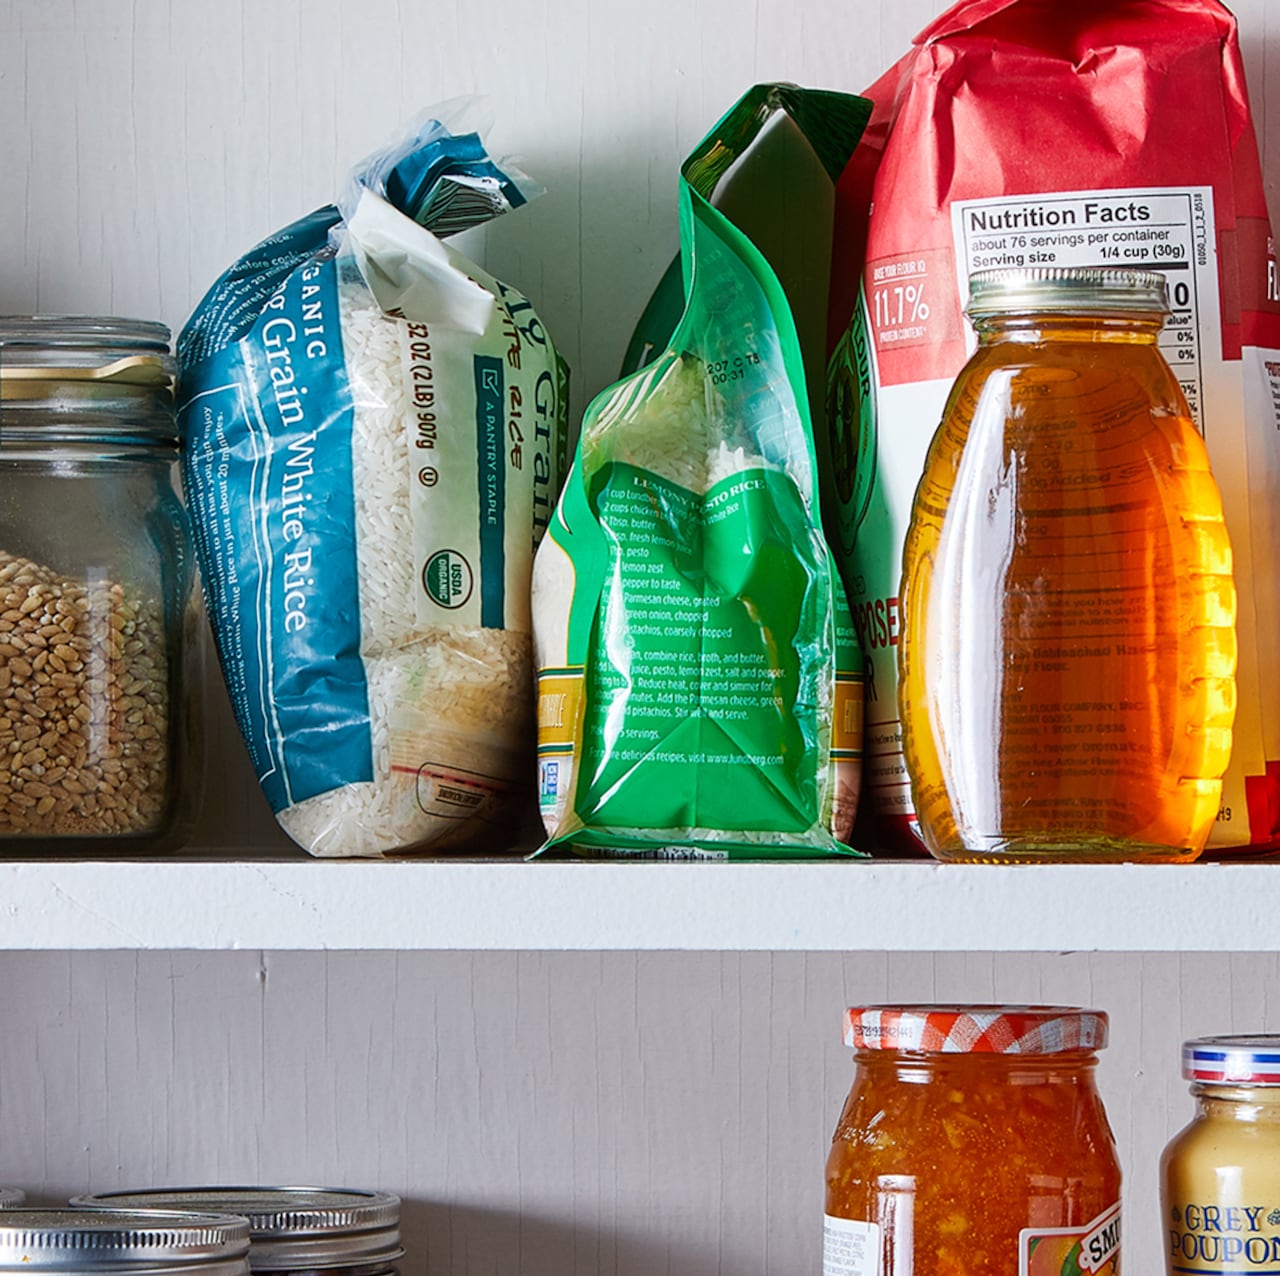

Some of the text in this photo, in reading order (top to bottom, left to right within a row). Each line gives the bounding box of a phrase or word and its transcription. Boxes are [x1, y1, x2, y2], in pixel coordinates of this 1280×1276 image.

[971, 202, 1151, 232] Nutrition Facts
[972, 228, 1170, 252] about 76 servings per container
[972, 250, 1056, 269] Serving size
[1100, 243, 1186, 260] 1/4 cup (30g)
[301, 263, 326, 360] GANIC
[874, 283, 930, 328] 11.7%
[407, 322, 428, 339] 32
[1177, 331, 1194, 342] 0%
[410, 341, 432, 361] OZ
[1178, 349, 1195, 360] 0%
[494, 303, 523, 471] ITE RICE
[412, 383, 434, 414] LB)
[203, 405, 217, 438] enjoy
[415, 413, 436, 450] 907g
[217, 463, 229, 479] 20
[484, 401, 497, 526] A PANTRY STAPLE
[261, 316, 318, 634] Grain White Rice
[730, 479, 765, 497] RICE
[219, 482, 232, 515] about
[222, 518, 236, 539] just
[626, 548, 650, 559] pesto
[225, 557, 237, 583] Rice
[622, 561, 664, 573] lemon zest
[437, 558, 449, 602] ORGANIC
[450, 564, 462, 597] USDA
[622, 578, 681, 590] pepper taste
[227, 585, 242, 623] White
[624, 592, 720, 608] Parmesan grated
[674, 610, 709, 623] chopped
[664, 624, 732, 639] coarsely chopped
[643, 651, 766, 664] combine butter.
[638, 679, 759, 692] Reduce simmer
[657, 693, 688, 704] Add the
[632, 706, 673, 718] pistachios.
[625, 728, 661, 741] servings.
[655, 751, 688, 765] recipes,
[1185, 1205, 1265, 1232] GREY
